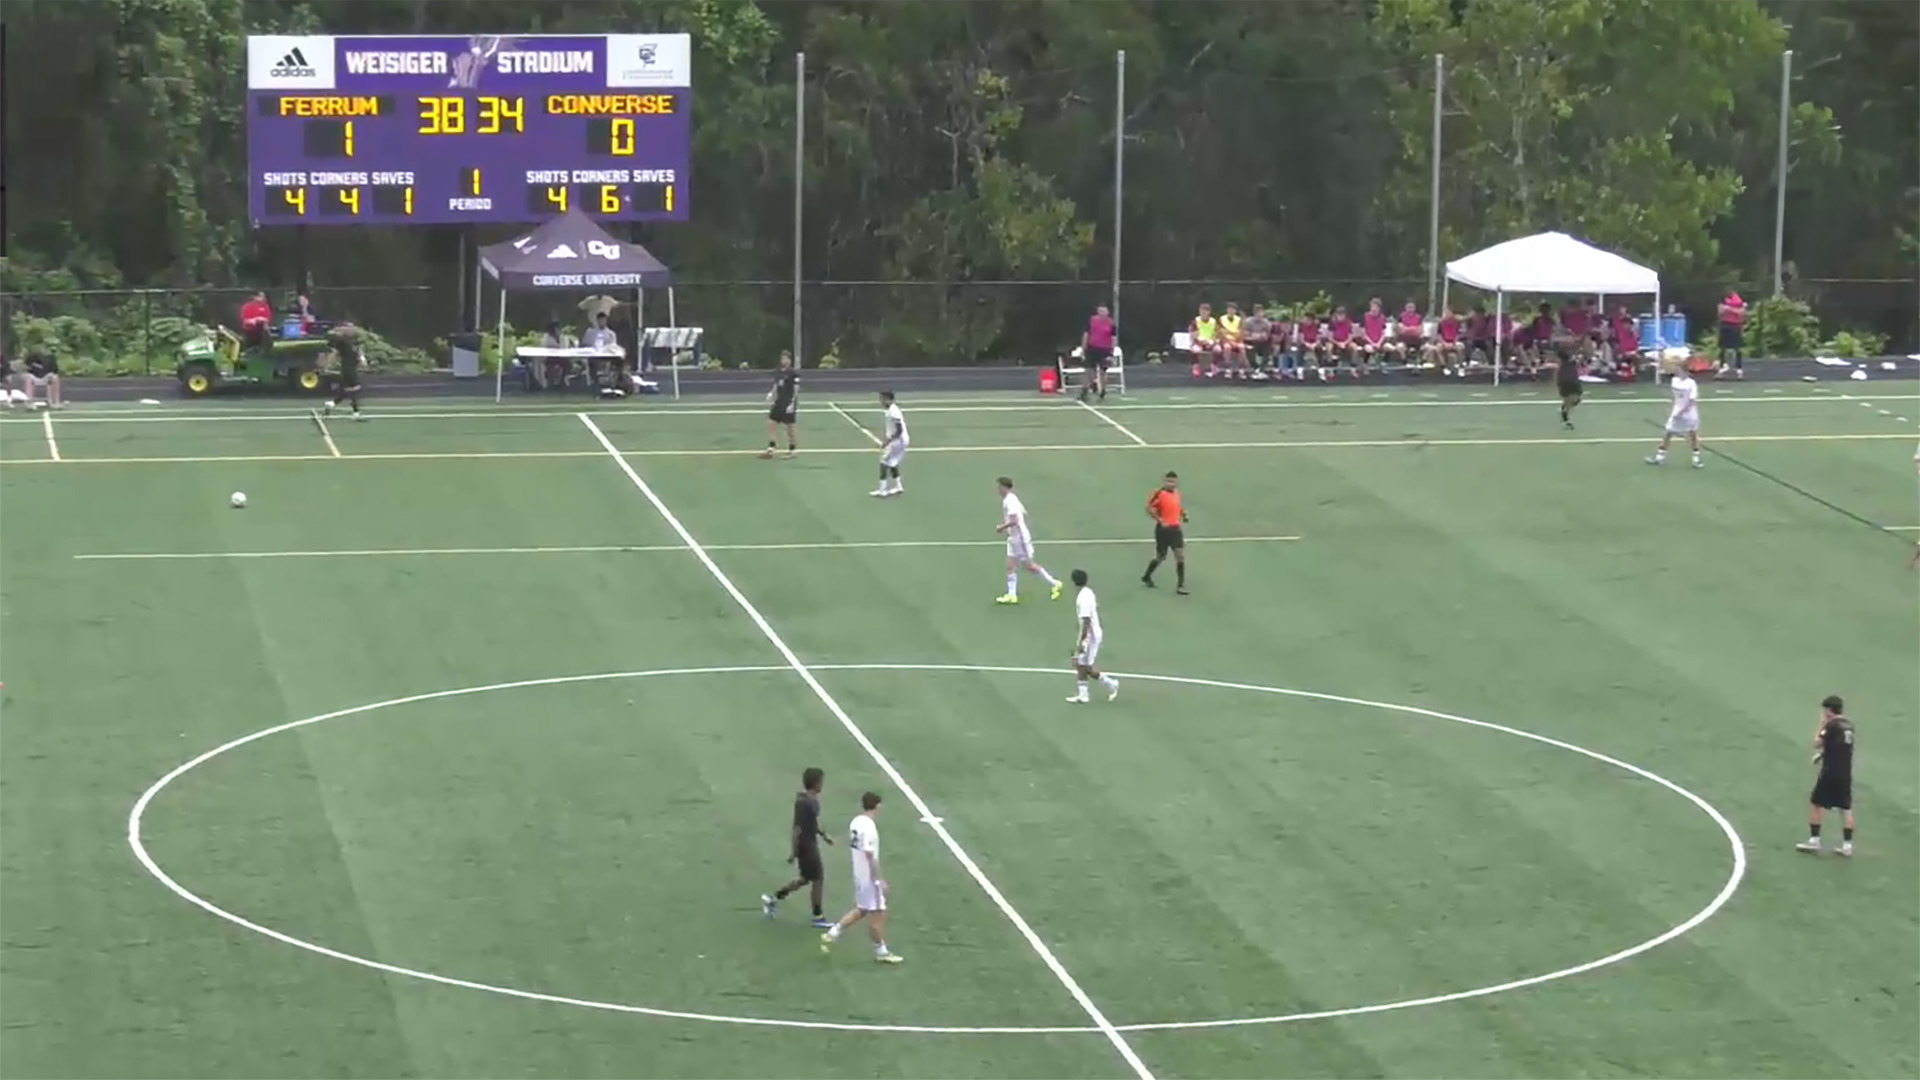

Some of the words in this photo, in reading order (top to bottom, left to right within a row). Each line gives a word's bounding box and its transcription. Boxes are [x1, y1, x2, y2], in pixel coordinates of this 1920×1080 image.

[270, 68, 316, 77] adidas
[345, 51, 448, 74] WEISIGER
[497, 51, 594, 73] STADIUM
[280, 96, 379, 116] FERRUM
[418, 97, 465, 133] 38
[477, 97, 524, 133] 34
[547, 95, 674, 114] CONVERSE
[345, 121, 353, 156] 1
[611, 118, 635, 155] 0
[264, 172, 307, 185] SHOTS
[310, 172, 368, 185] CORNERS
[372, 172, 415, 185] SAVES
[473, 168, 480, 195] 1
[526, 170, 569, 184] SHOTS
[572, 170, 629, 183] CORNERS
[633, 169, 675, 182] SAVES
[285, 187, 305, 215] 4
[340, 187, 359, 215] 4
[405, 187, 412, 215] 1
[449, 198, 492, 210] PERIOD
[548, 186, 568, 212] 4
[601, 185, 620, 213] 6
[665, 185, 673, 212] 1
[533, 274, 584, 286] CONVERSE
[585, 273, 642, 286] UNIVERSITY
